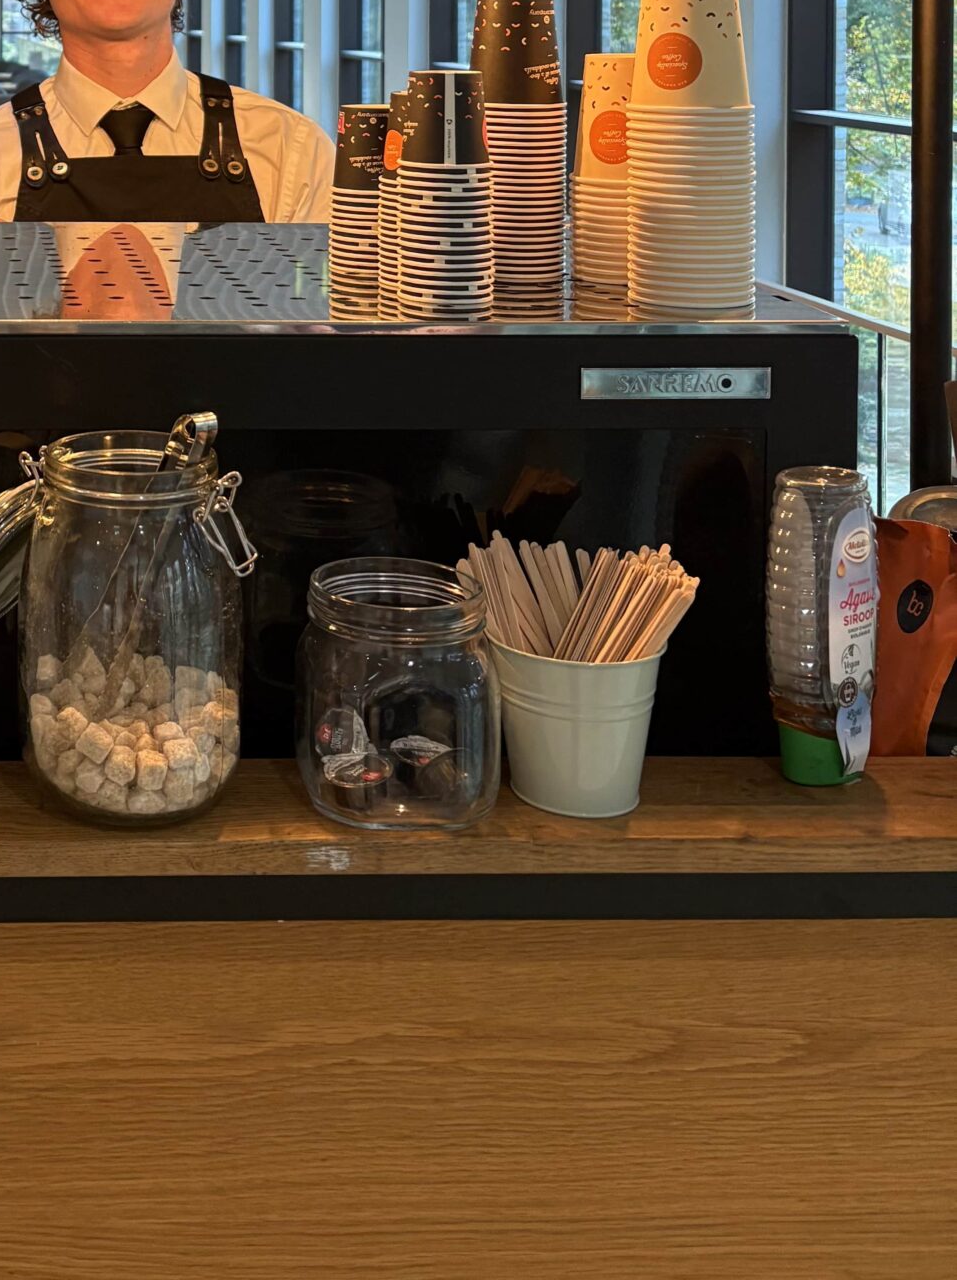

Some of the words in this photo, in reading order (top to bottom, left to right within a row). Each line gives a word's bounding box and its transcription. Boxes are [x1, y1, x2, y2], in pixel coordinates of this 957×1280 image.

[662, 54, 682, 62] Coffee
[617, 373, 735, 394] SANREMO
[843, 608, 874, 626] SIROOP
